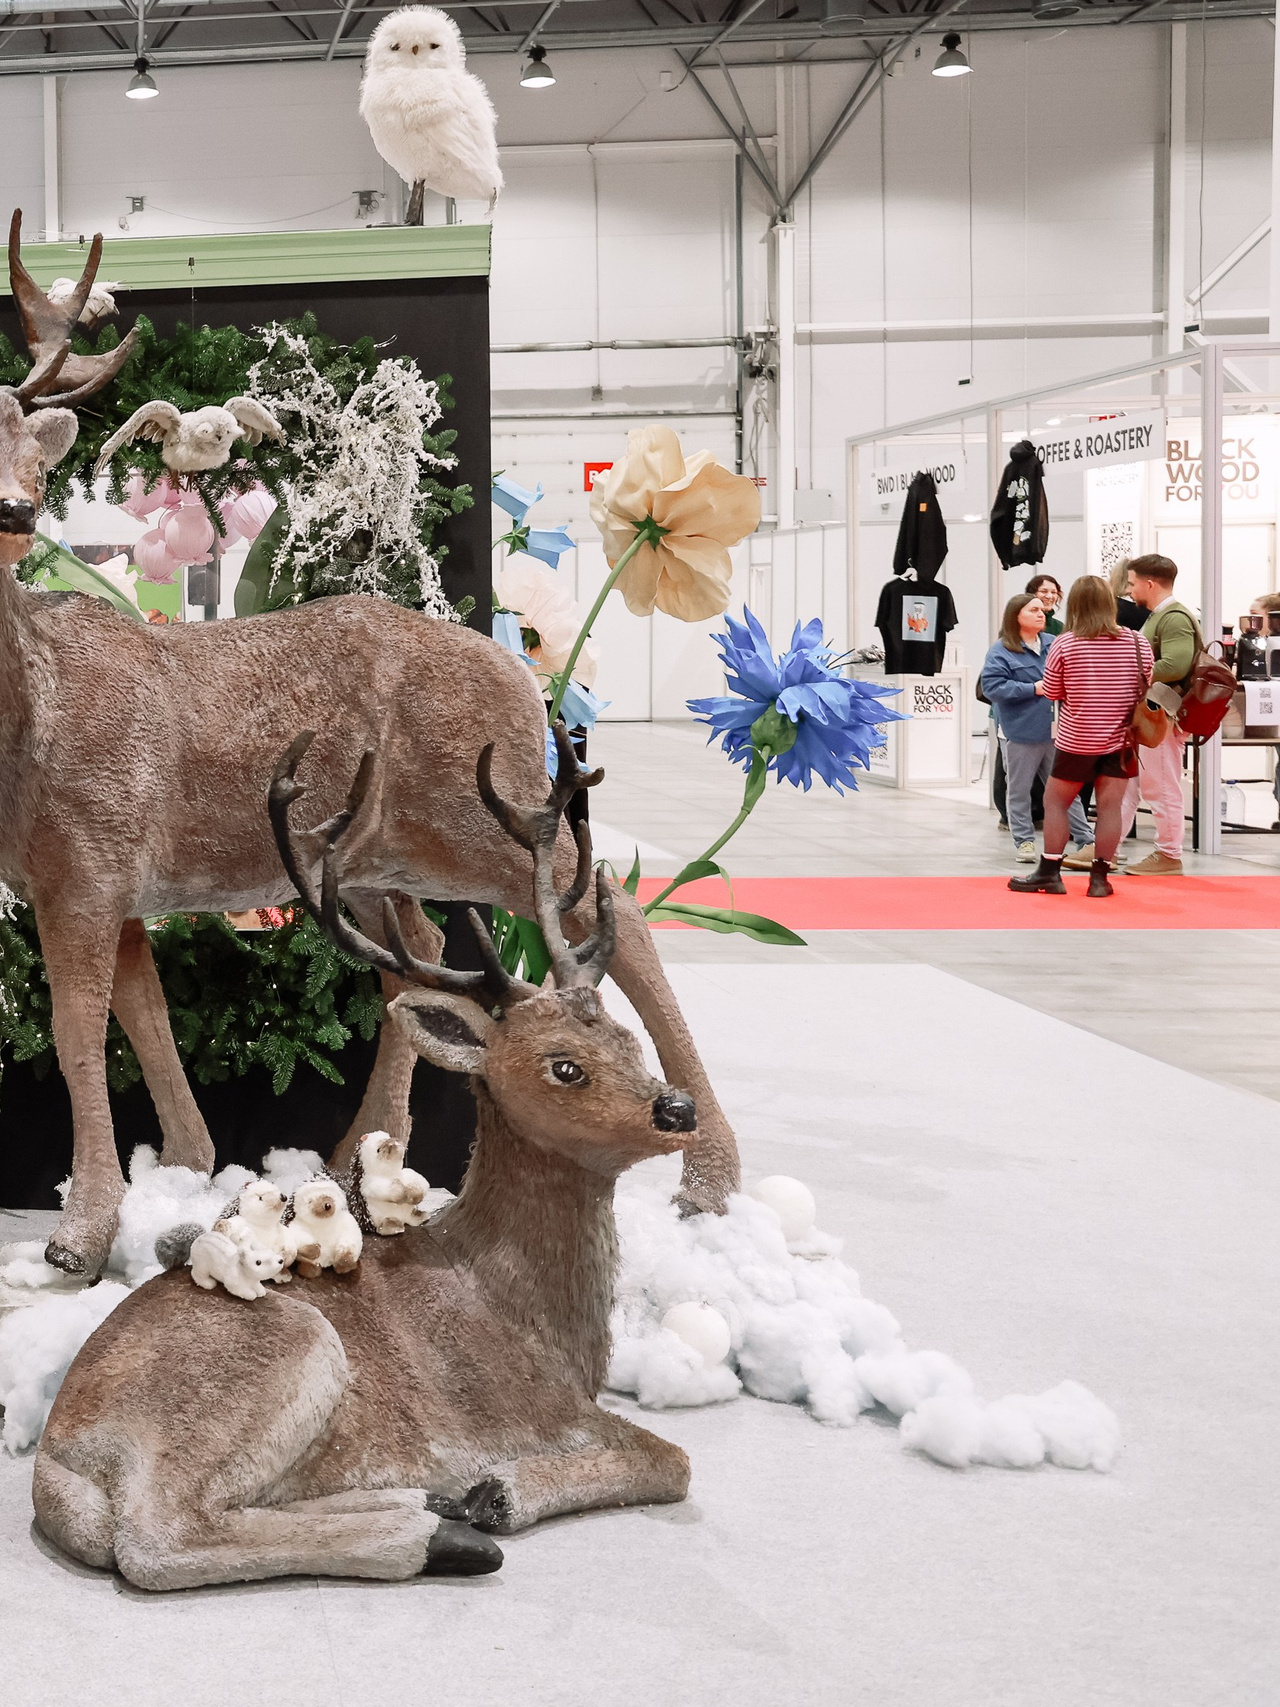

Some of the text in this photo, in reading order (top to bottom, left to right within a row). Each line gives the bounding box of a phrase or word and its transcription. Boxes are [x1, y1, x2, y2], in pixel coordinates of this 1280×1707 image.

[1037, 424, 1153, 464] OFFEE & ROASTERY
[1167, 438, 1256, 461] BLCK
[877, 476, 895, 494] BWD
[1221, 484, 1259, 500] OU
[914, 685, 952, 695] BLACK
[914, 695, 954, 705] WOOD
[913, 704, 954, 713] FOR YOU
